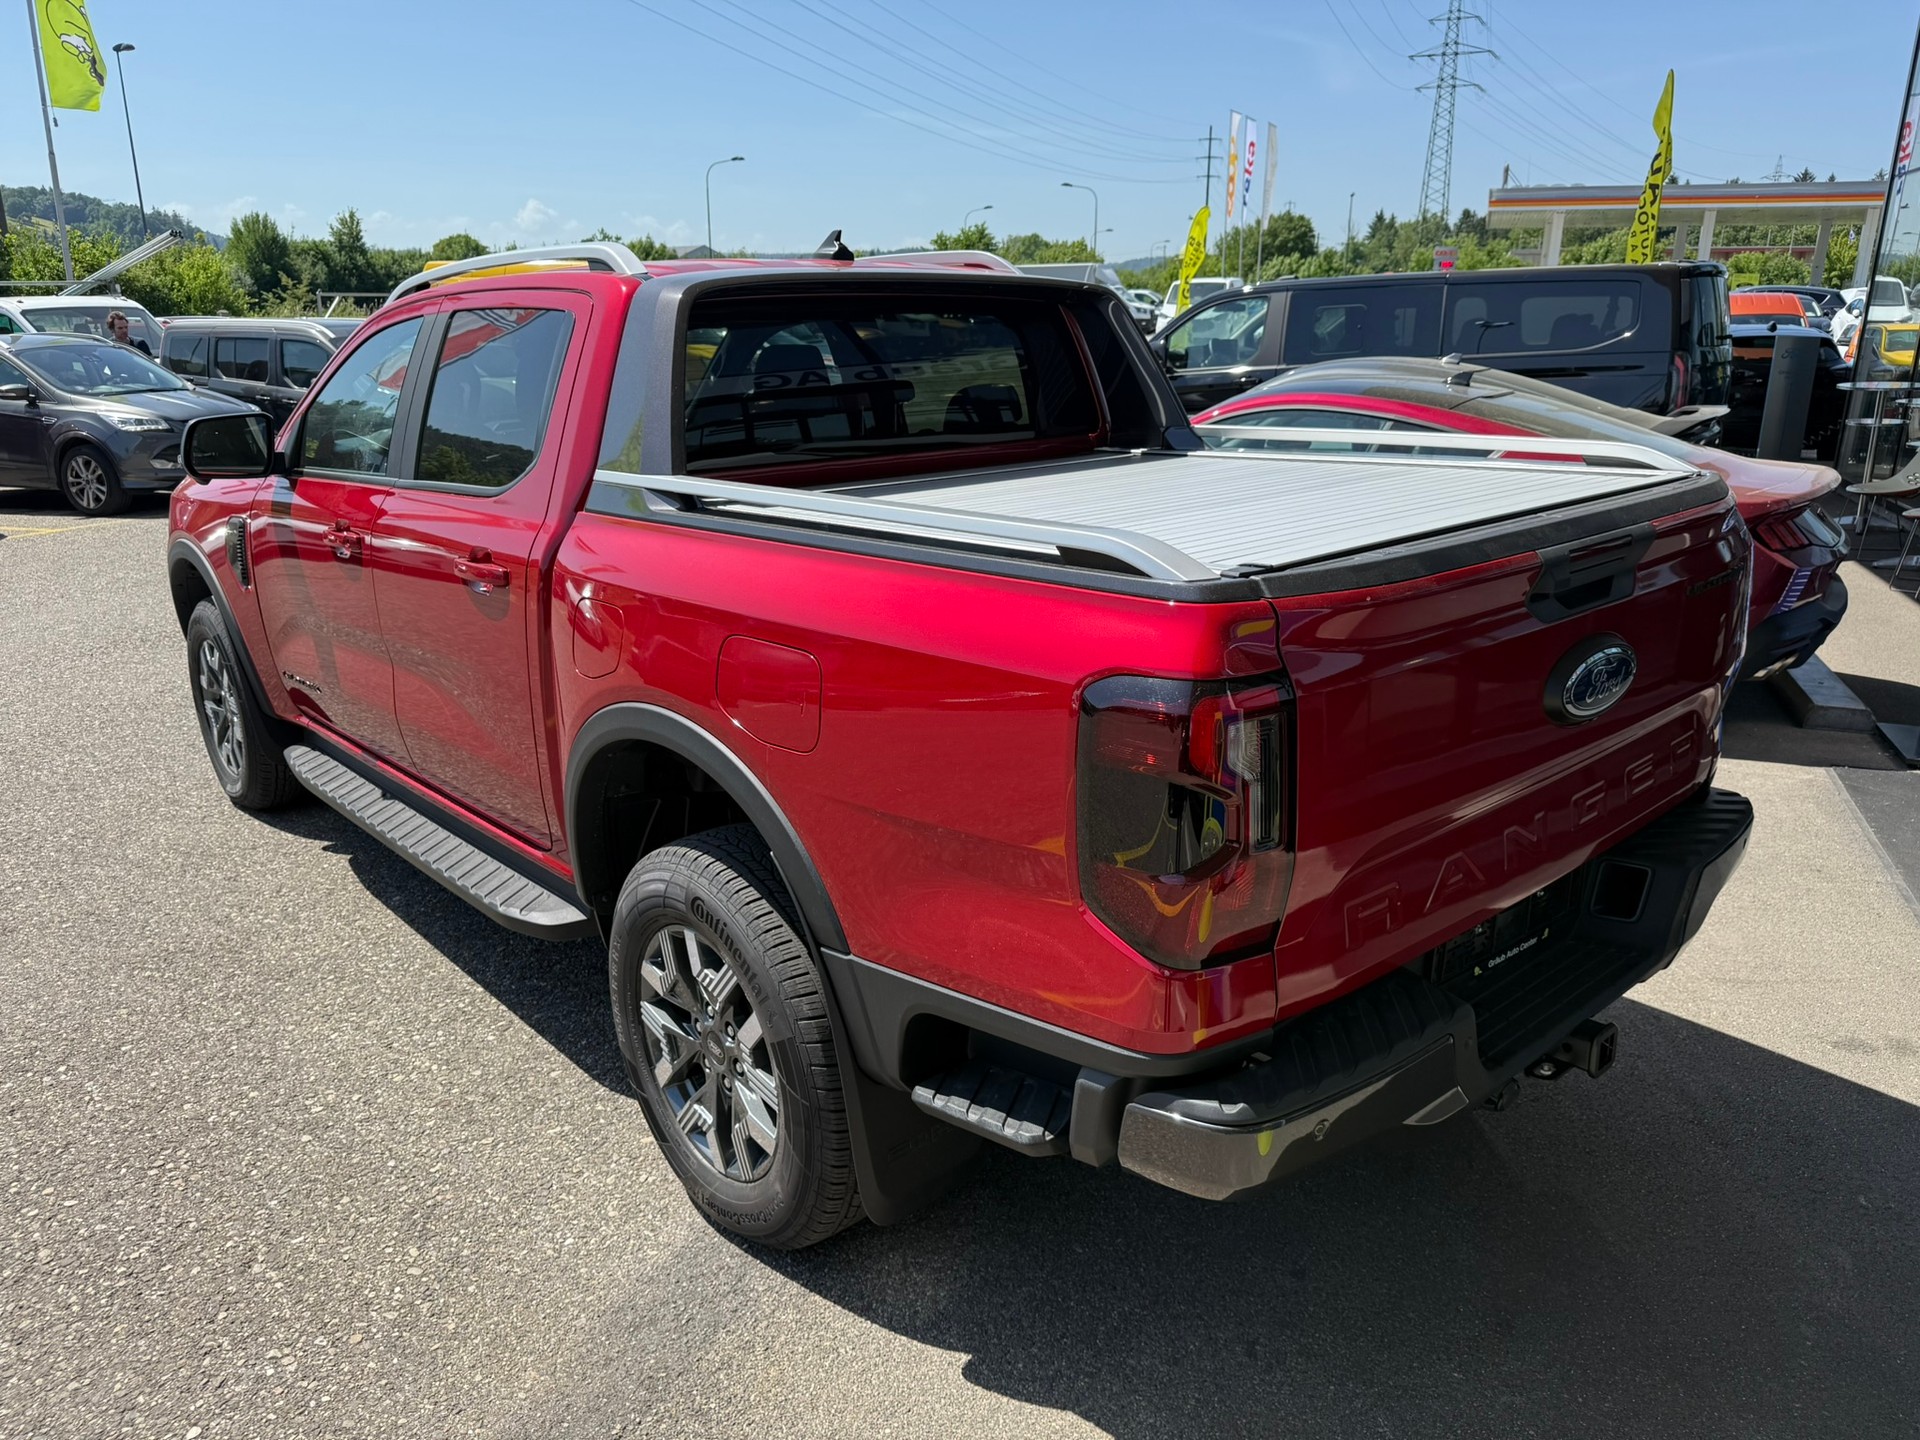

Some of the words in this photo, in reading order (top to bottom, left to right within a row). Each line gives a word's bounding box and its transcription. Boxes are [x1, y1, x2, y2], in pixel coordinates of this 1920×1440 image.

[1584, 659, 1628, 704] Ford
[1344, 713, 1699, 951] RANGER
[690, 896, 768, 1006] Continental
[1506, 946, 1520, 959] Auto
[1520, 936, 1538, 951] Center
